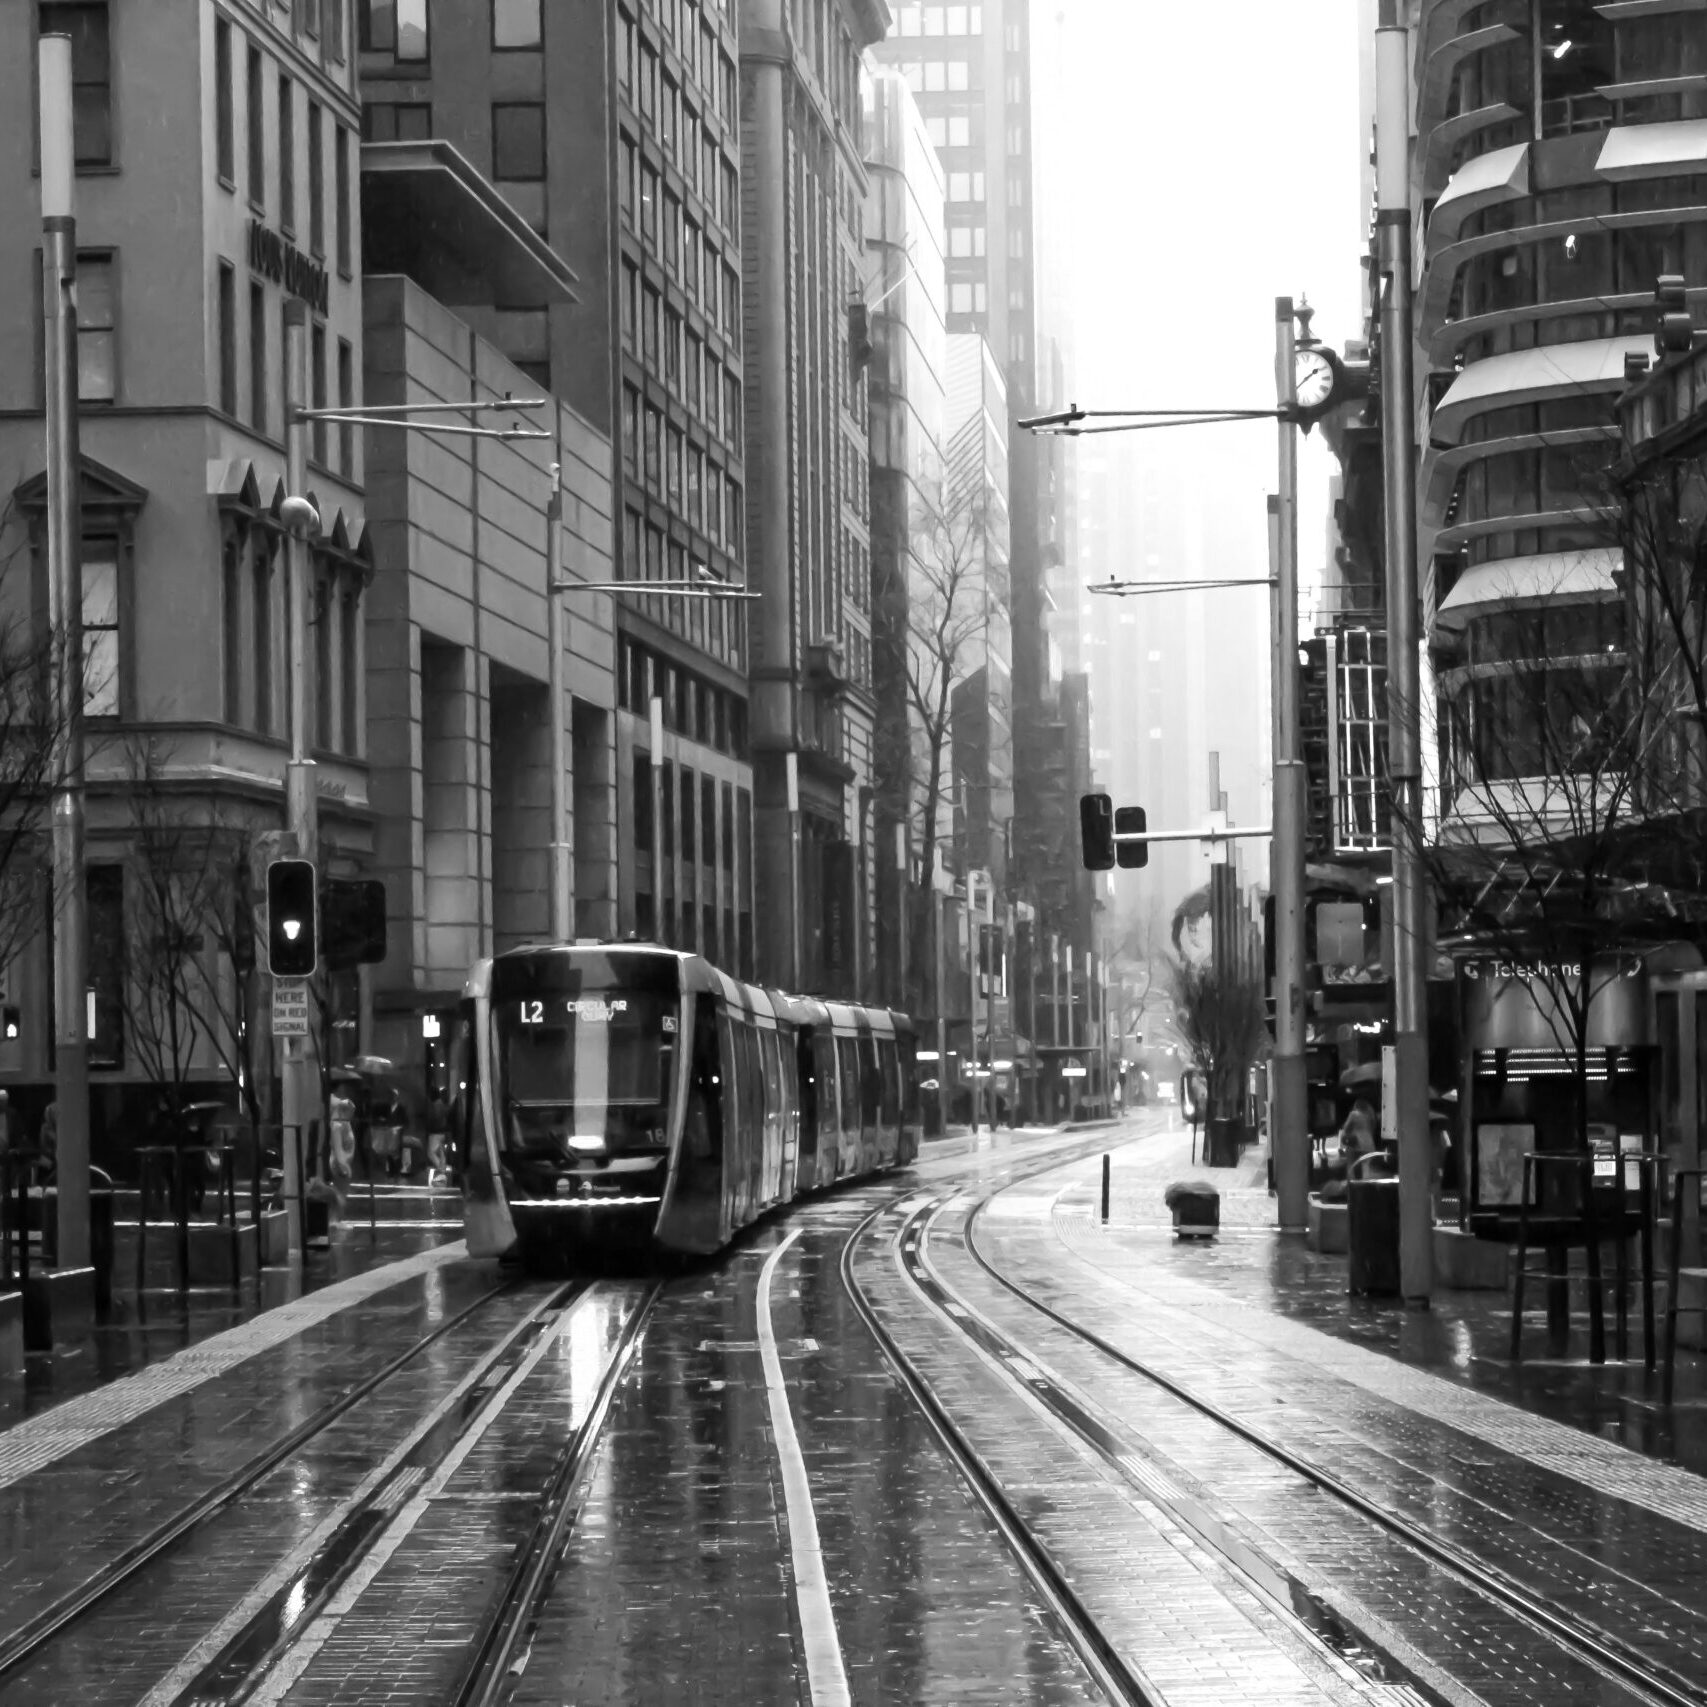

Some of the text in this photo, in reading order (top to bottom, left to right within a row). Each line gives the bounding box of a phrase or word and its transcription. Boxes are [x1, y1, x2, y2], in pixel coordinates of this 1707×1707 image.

[275, 991, 305, 1003] HERE
[520, 1001, 543, 1023] L2
[274, 1022, 306, 1032] SIGNAL
